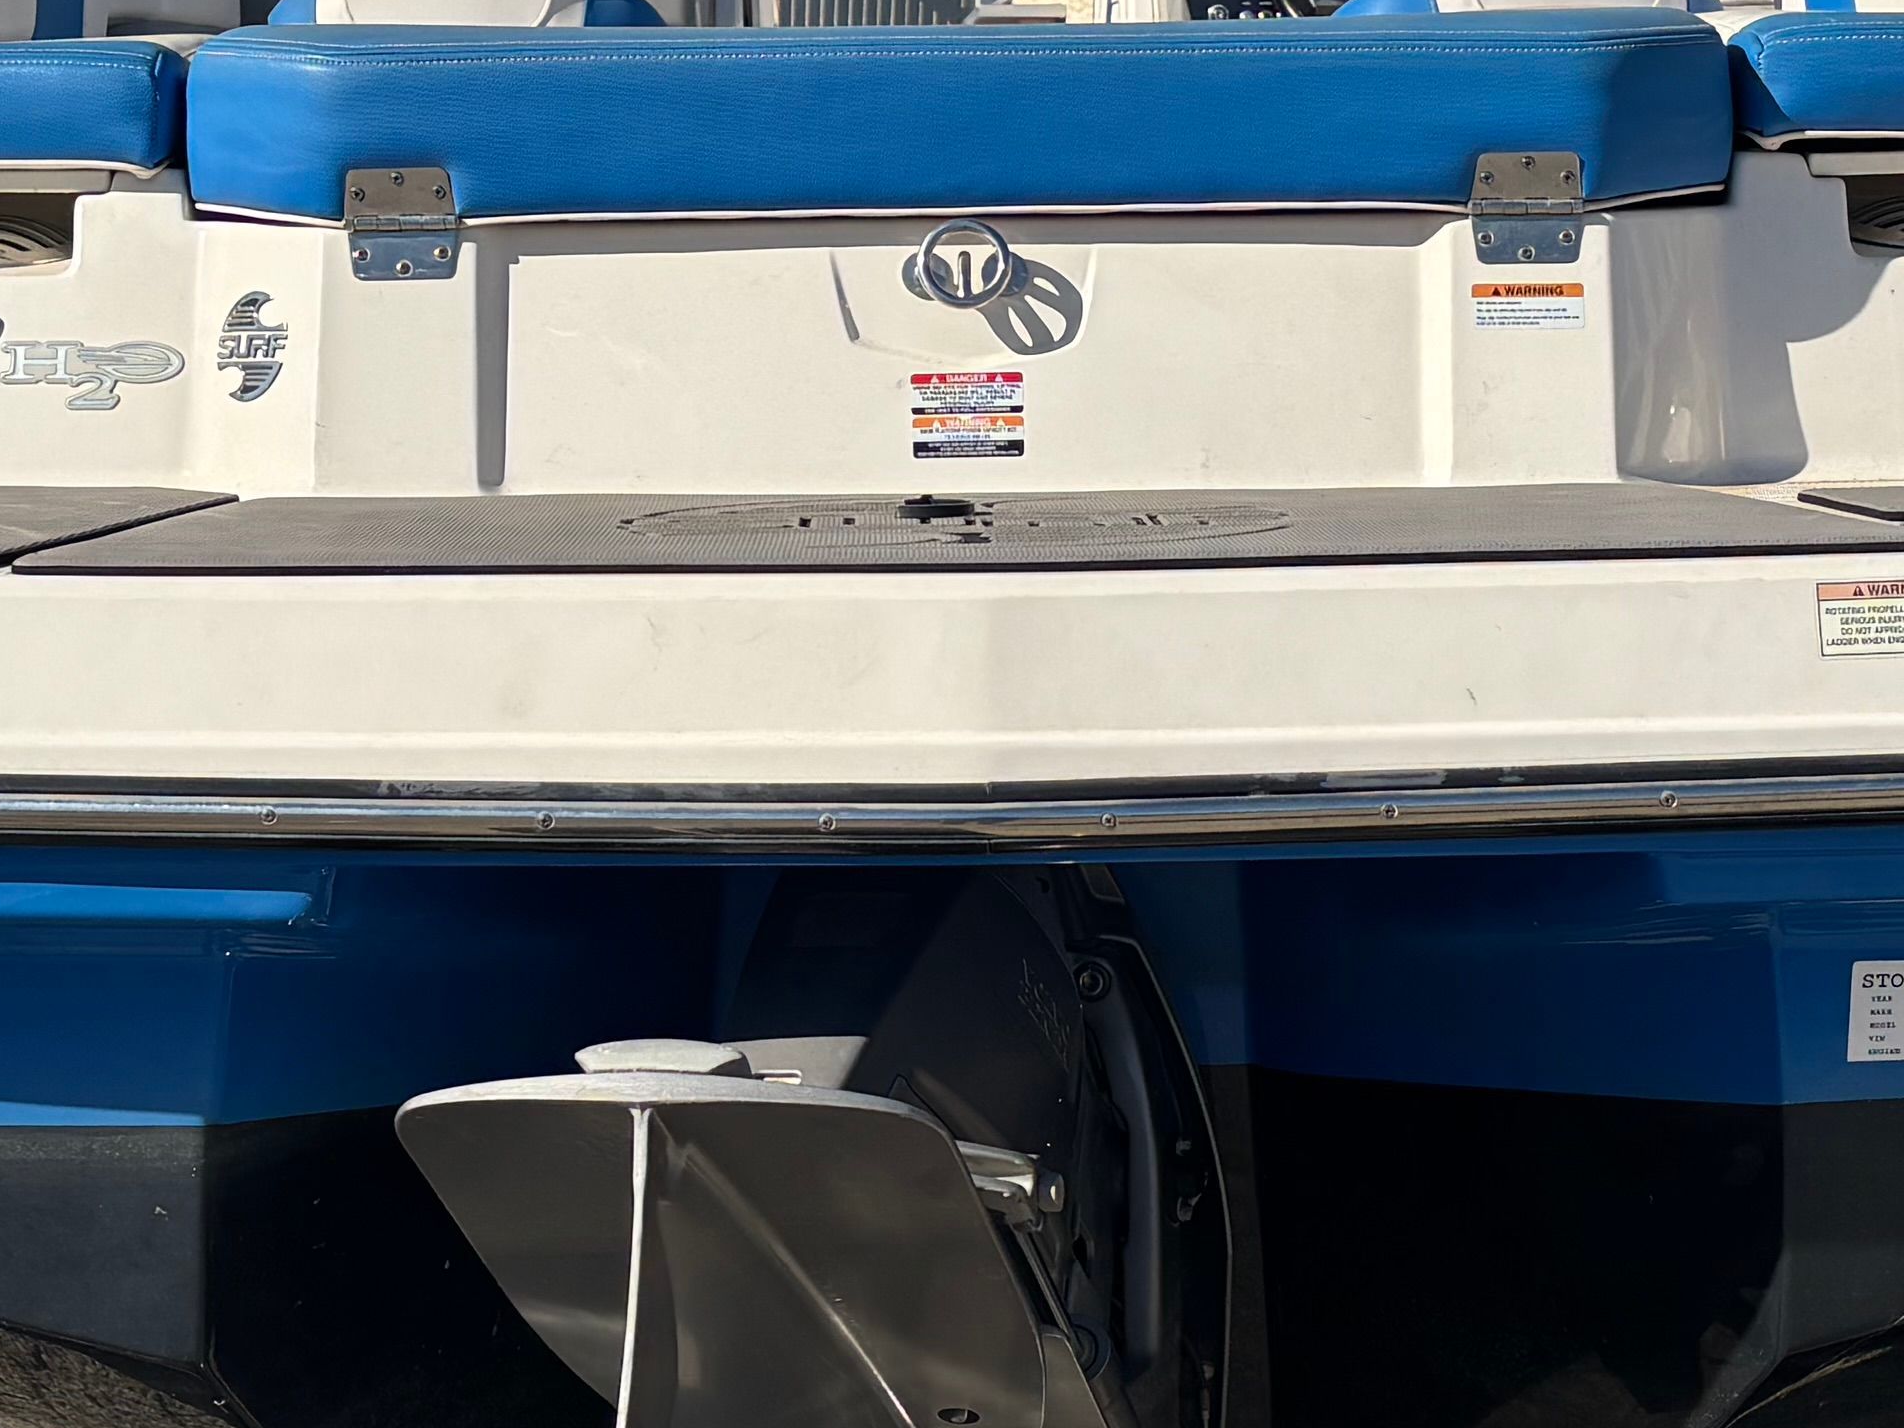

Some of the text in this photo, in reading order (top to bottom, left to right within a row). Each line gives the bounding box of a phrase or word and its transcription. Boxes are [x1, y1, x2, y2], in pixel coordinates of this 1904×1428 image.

[1504, 285, 1564, 296] WARNING
[217, 334, 288, 359] SURF
[945, 374, 988, 383] DANGER
[1841, 627, 1853, 635] DO
[1855, 626, 1871, 634] NOT
